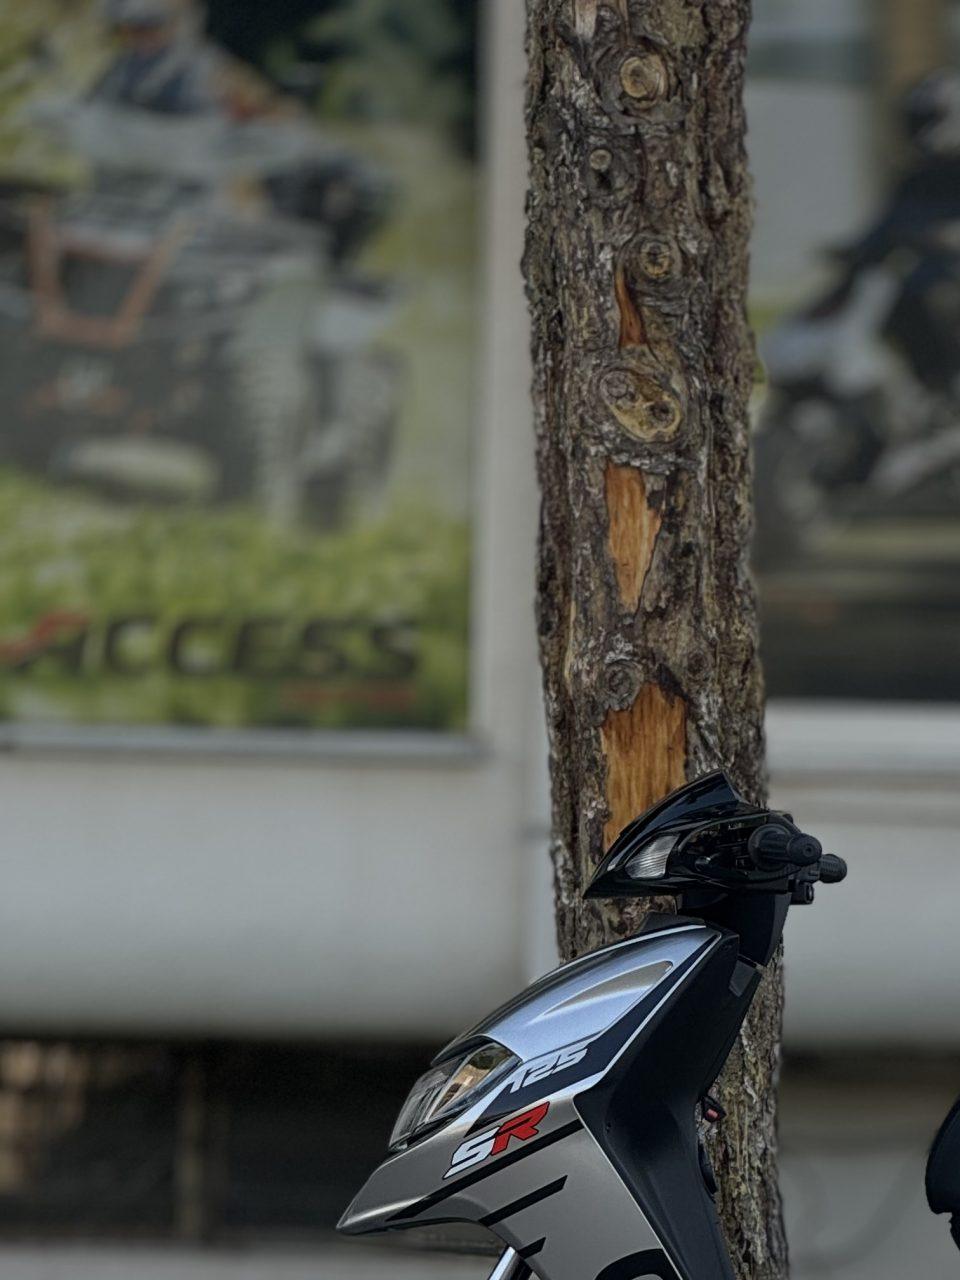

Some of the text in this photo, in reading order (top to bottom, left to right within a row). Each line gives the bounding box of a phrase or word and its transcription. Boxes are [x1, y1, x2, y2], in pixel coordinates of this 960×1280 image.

[0, 612, 420, 679] ACCESS
[512, 1048, 588, 1093] 125
[442, 1101, 550, 1180] SR
